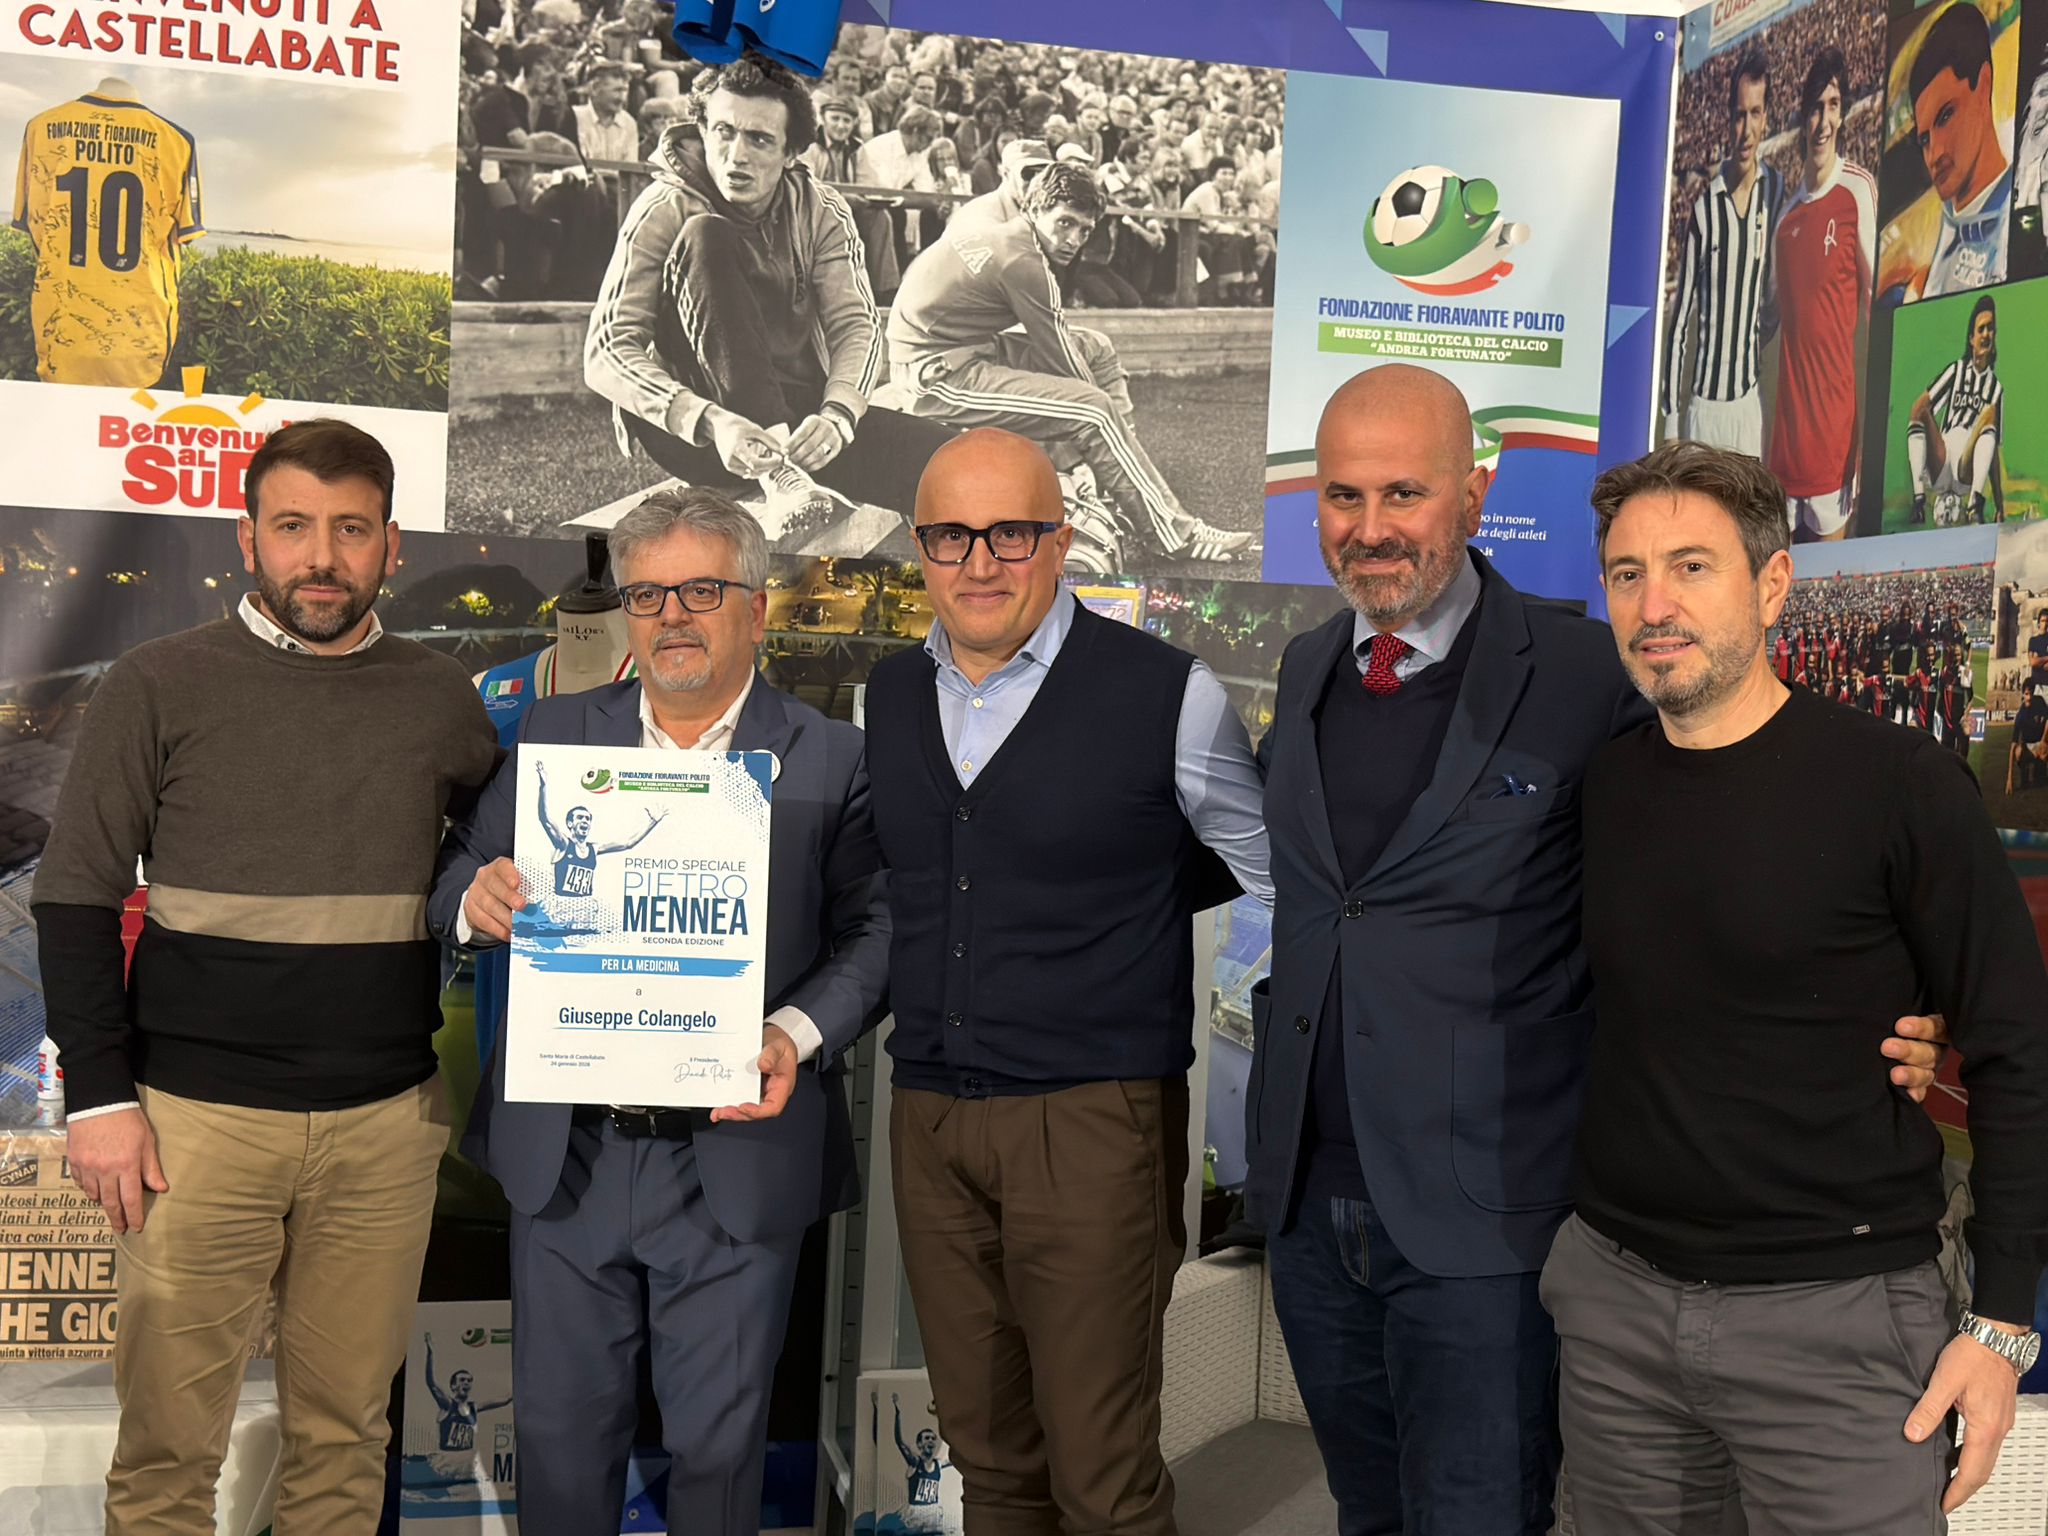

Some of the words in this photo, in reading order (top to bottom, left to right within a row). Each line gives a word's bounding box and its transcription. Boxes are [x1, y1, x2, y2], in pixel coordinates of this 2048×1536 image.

[18, 3, 400, 82] CASTELLABATE
[104, 124, 158, 149] FIORAVANTE
[75, 140, 135, 165] POLITO
[56, 166, 144, 272] 10
[1318, 297, 1413, 322] FONDAZIONE
[1417, 304, 1509, 329] FIORAVANTE
[1513, 311, 1565, 332] POLITO
[1333, 326, 1382, 341] MUSEO
[1384, 330, 1393, 341] E
[1394, 332, 1472, 348] BIBLIOTECA
[1474, 337, 1500, 349] DEL
[1501, 338, 1549, 352] CALCIO
[1492, 513, 1504, 524] in
[1505, 516, 1536, 526] nome
[1489, 527, 1517, 541] degli
[1517, 529, 1547, 541] atleti
[690, 774, 711, 782] POLITO
[624, 857, 678, 870] PREMIO
[681, 859, 746, 872] SPECIALE
[624, 871, 748, 900] PIETRO
[622, 895, 749, 935] MENNEA
[642, 935, 683, 945] SECONDA
[685, 937, 725, 946] EDIZIONE
[601, 959, 620, 970] PER
[621, 959, 633, 971] LA
[636, 959, 680, 973] MEDICINA
[635, 988, 642, 997] a
[559, 1007, 633, 1029] Giuseppe
[638, 1009, 717, 1032] Colangelo
[0, 1164, 38, 1185] CYNAR
[41, 1193, 77, 1208] nello
[38, 1210, 52, 1225] in
[59, 1210, 106, 1225] delirio
[60, 1228, 89, 1243] l'oro
[0, 1251, 117, 1291] ENNE
[28, 1346, 65, 1359] vittoria
[67, 1348, 104, 1359] azzurra
